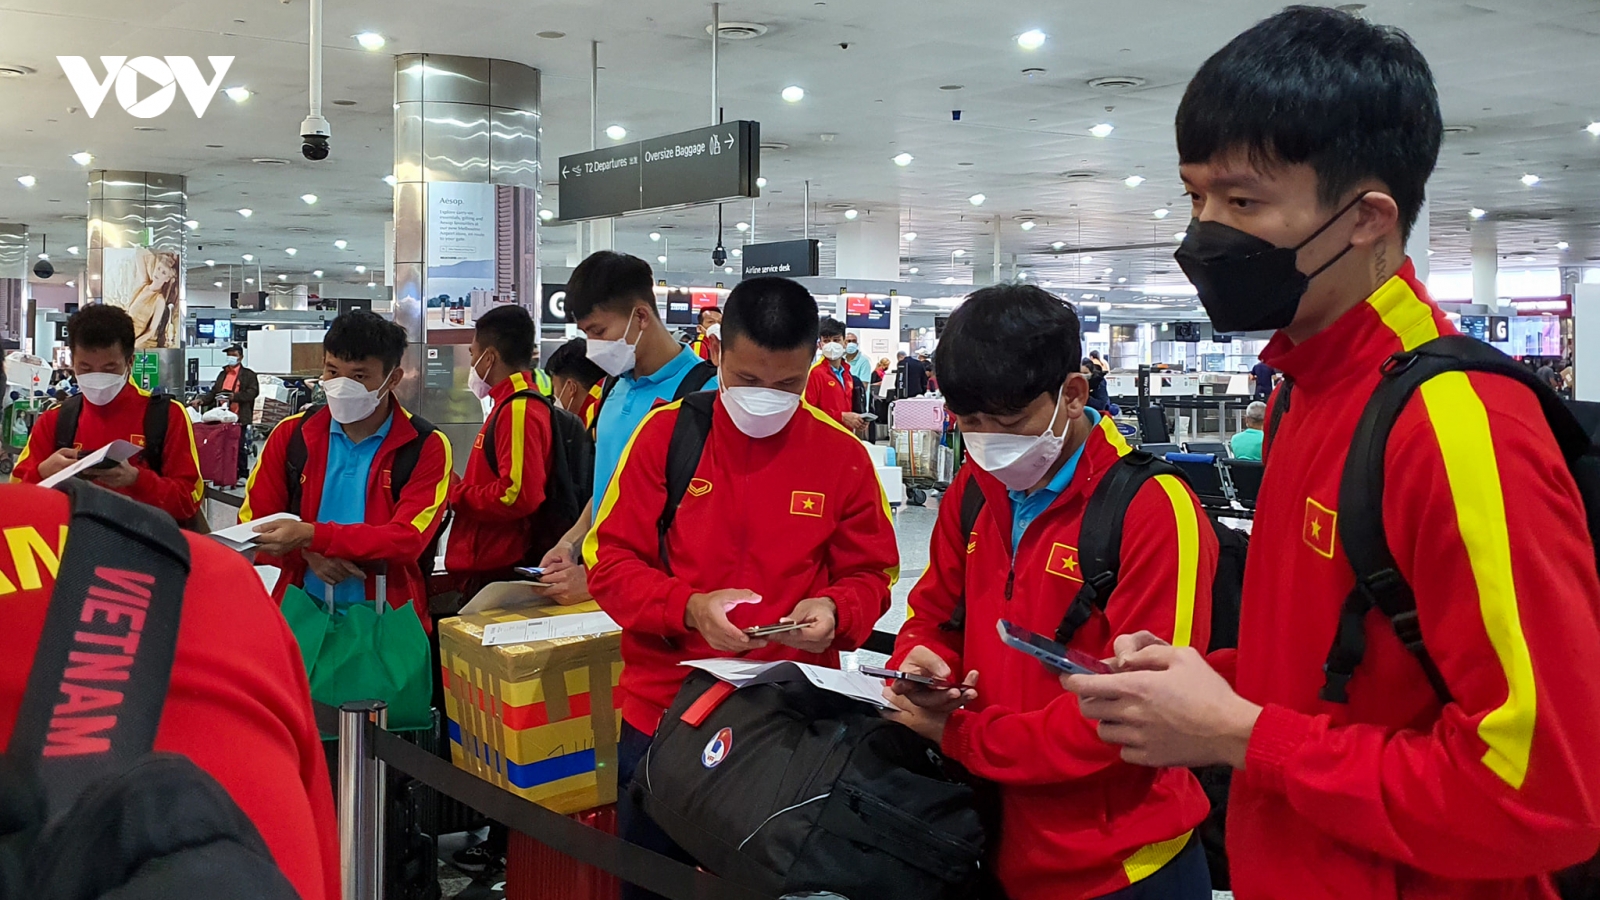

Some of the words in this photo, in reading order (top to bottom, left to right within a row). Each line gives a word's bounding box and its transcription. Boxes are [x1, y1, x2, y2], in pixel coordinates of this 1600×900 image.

[645, 147, 674, 163] Oversize
[675, 142, 706, 158] Baggage
[585, 162, 593, 173] T2
[594, 157, 627, 173] Departures
[745, 266, 761, 275] Airline
[762, 264, 778, 274] service
[779, 263, 791, 272] desk
[1496, 321, 1507, 339] G
[43, 566, 156, 757] VIETNAM
